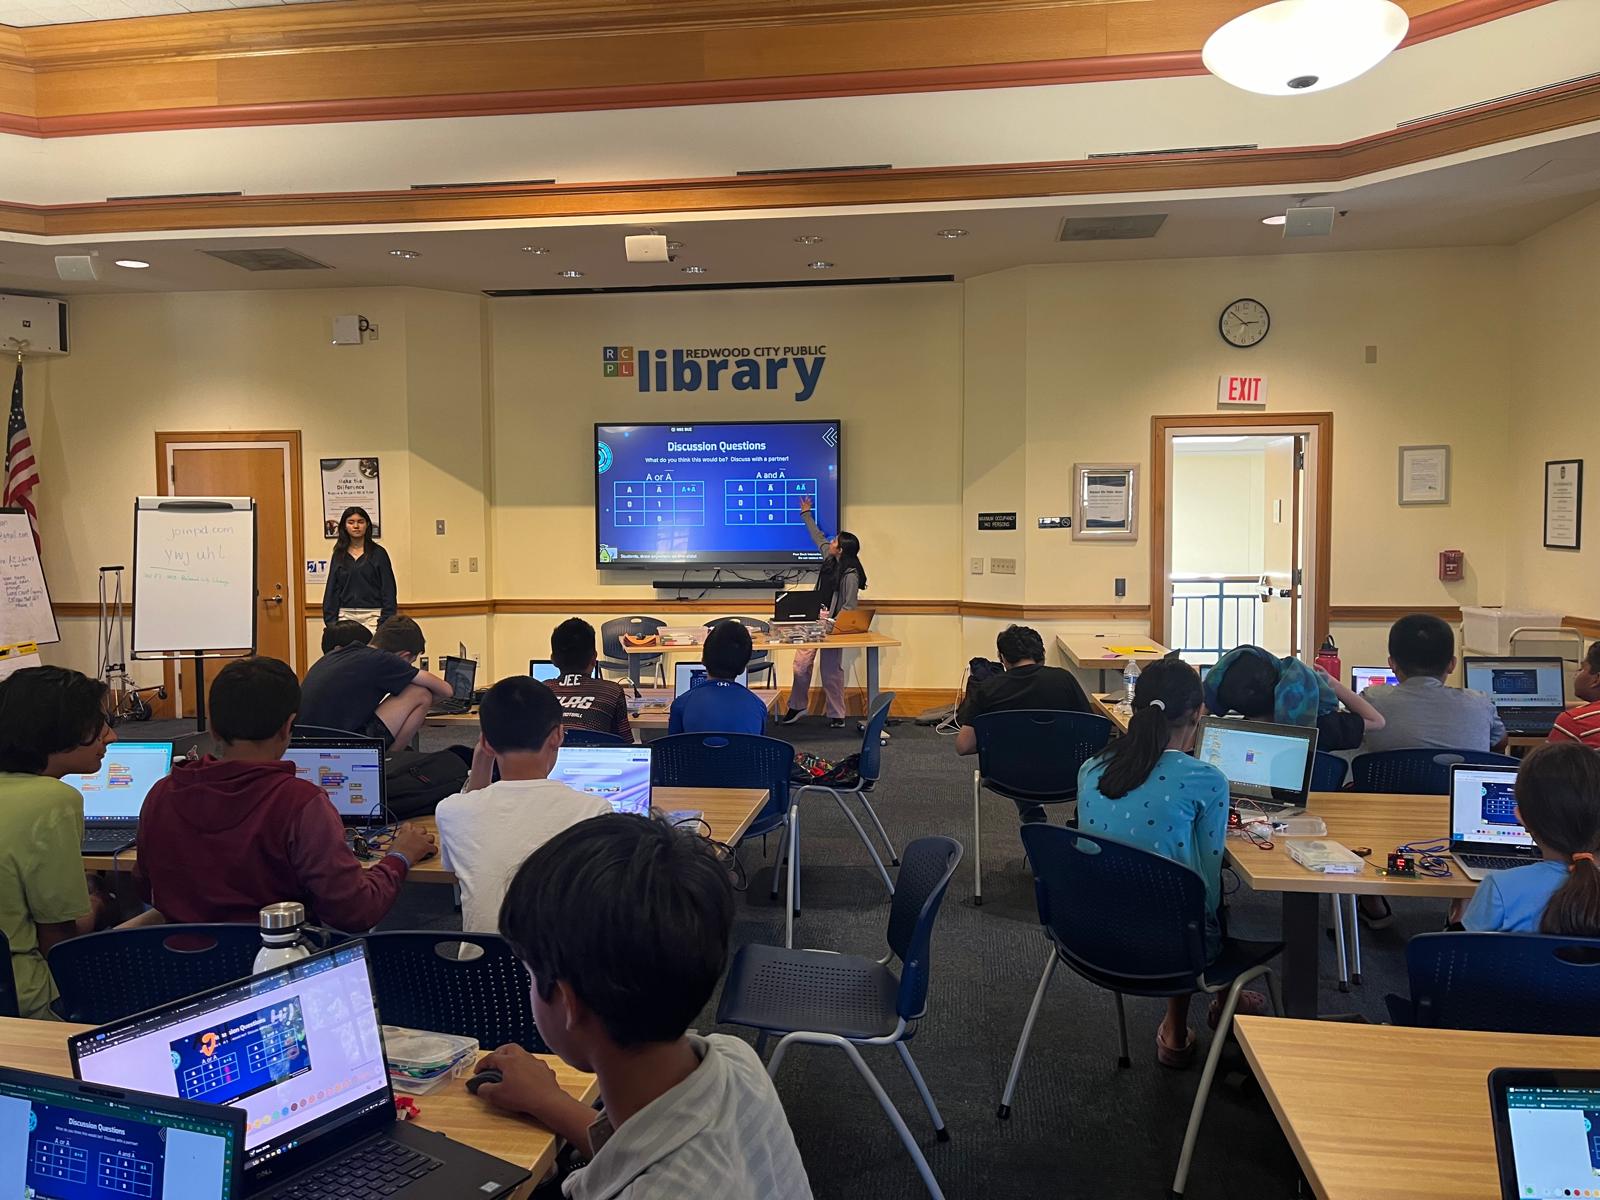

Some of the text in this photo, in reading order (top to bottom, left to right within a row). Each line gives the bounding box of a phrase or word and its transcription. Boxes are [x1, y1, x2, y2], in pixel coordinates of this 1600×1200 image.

[606, 349, 628, 359] R C
[686, 345, 826, 359] REDWOOD CITY PUBLIC
[607, 365, 628, 374] P L
[638, 349, 826, 402] library
[1228, 377, 1261, 401] EXIT
[668, 441, 766, 452] Discussion Questions
[559, 674, 582, 686] JEE
[556, 696, 595, 709] LAG
[69, 1118, 125, 1135] Discussion Questions
